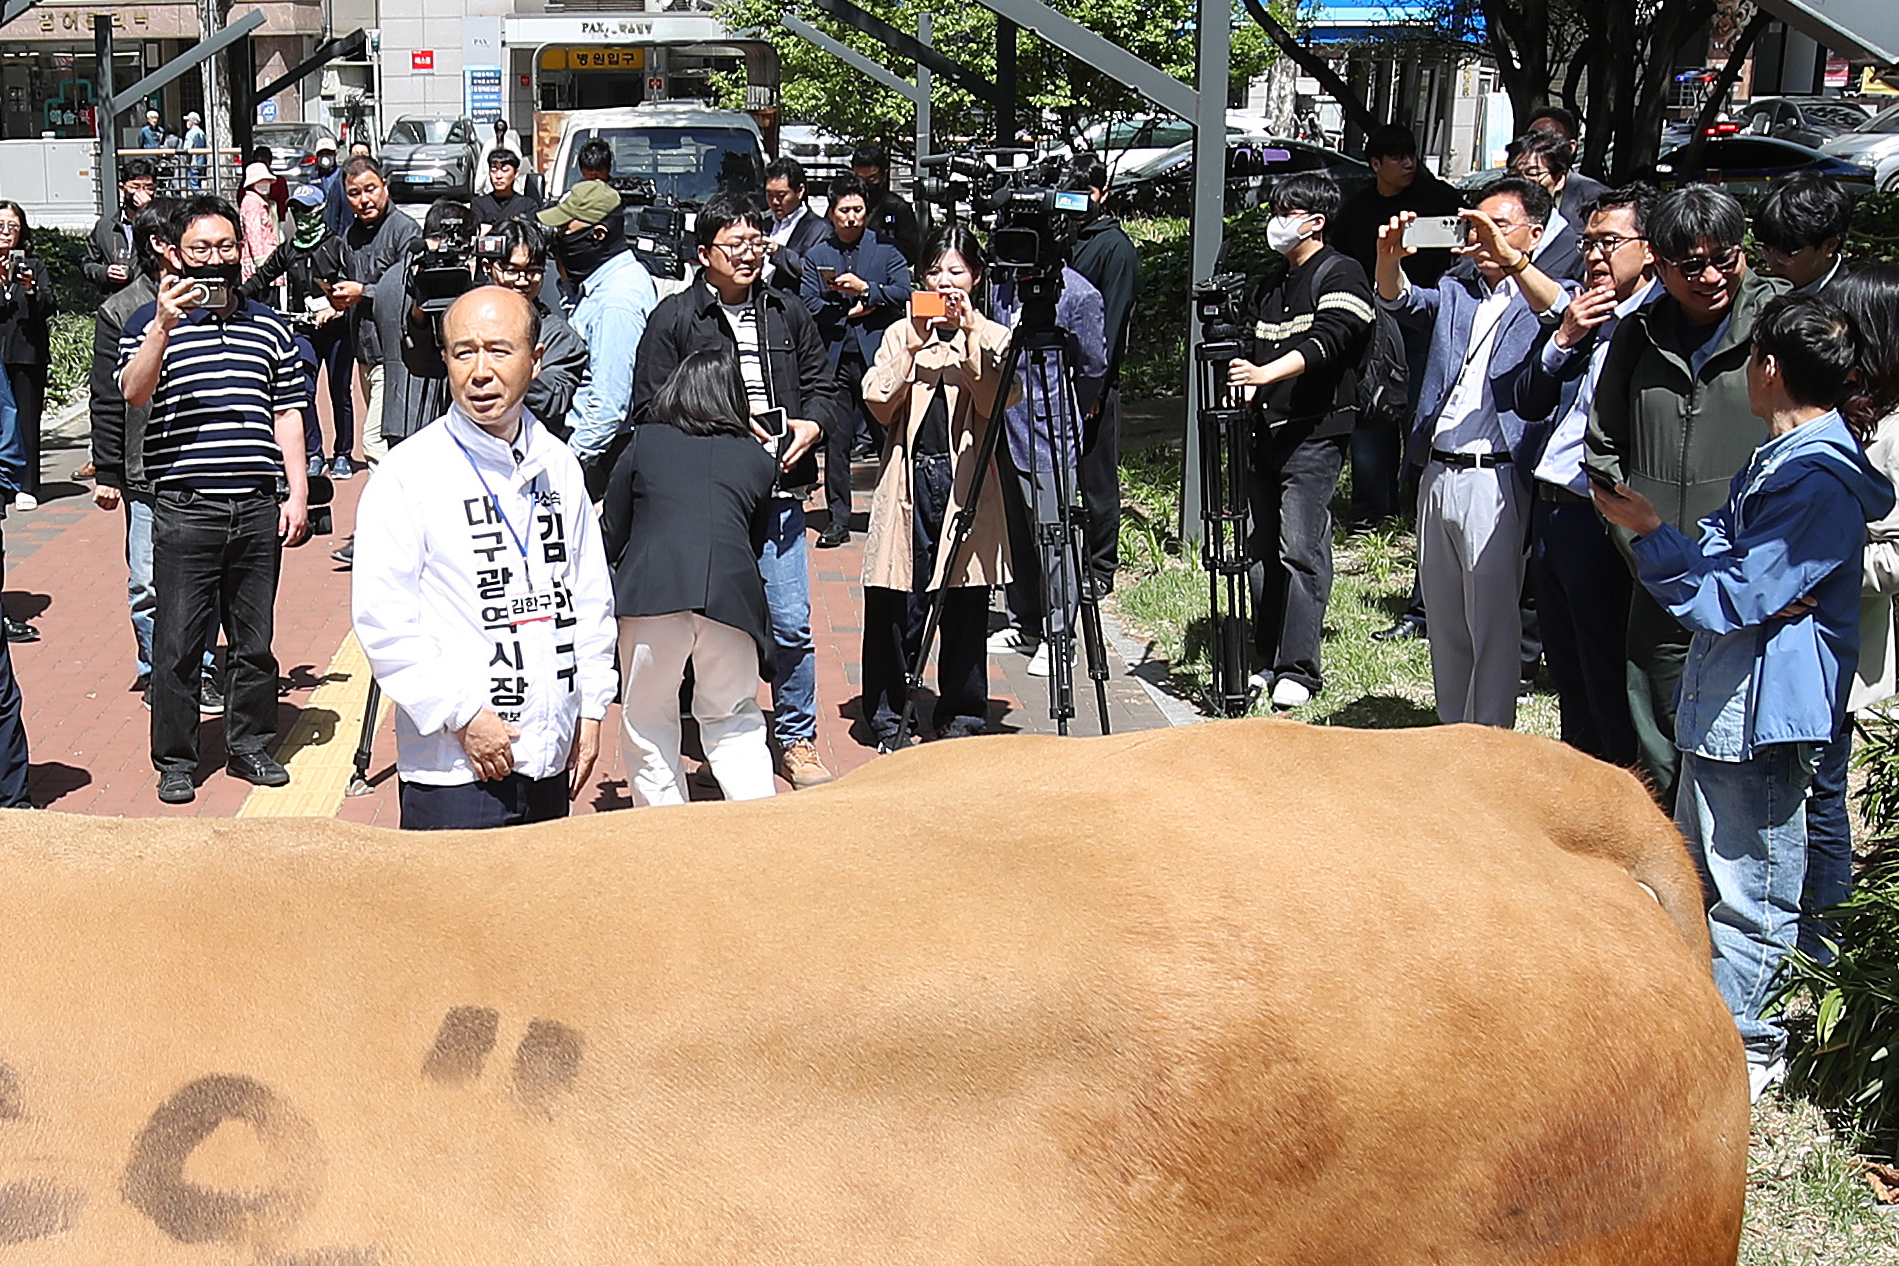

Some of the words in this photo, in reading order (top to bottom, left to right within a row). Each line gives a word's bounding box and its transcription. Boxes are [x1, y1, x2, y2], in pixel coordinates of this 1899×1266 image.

[576, 52, 634, 66] 병원입구
[464, 494, 529, 707] 대구광역시장
[511, 595, 552, 615] 김한구
